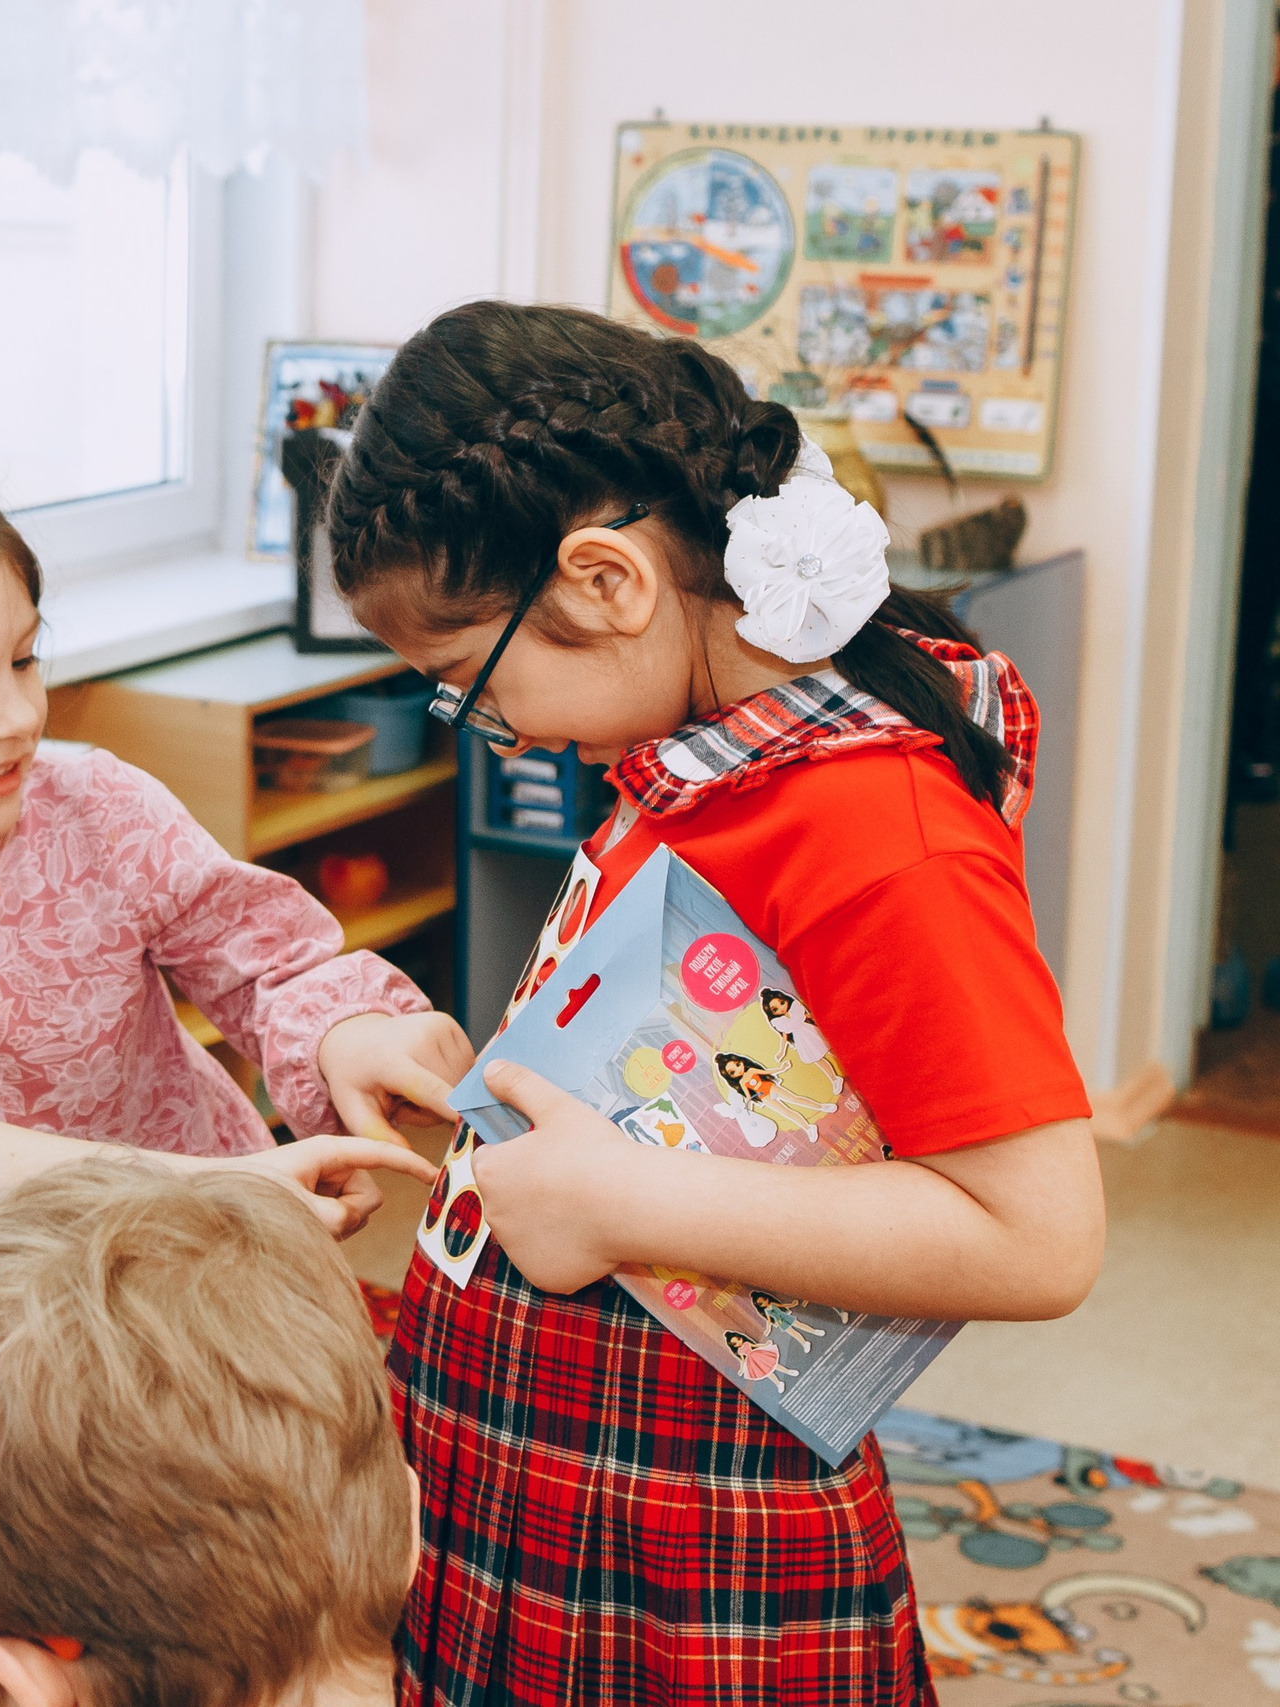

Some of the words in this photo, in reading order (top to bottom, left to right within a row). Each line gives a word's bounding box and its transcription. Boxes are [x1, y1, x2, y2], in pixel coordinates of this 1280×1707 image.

[688, 942, 718, 974] ПОДБЕРИ
[702, 956, 726, 980] КУКЛЕ
[709, 959, 742, 996] СТИЛЬНЫЙ
[726, 977, 750, 1000] НАРЯД
[836, 1136, 851, 1151] НА
[846, 1138, 872, 1164] НАРЯД
